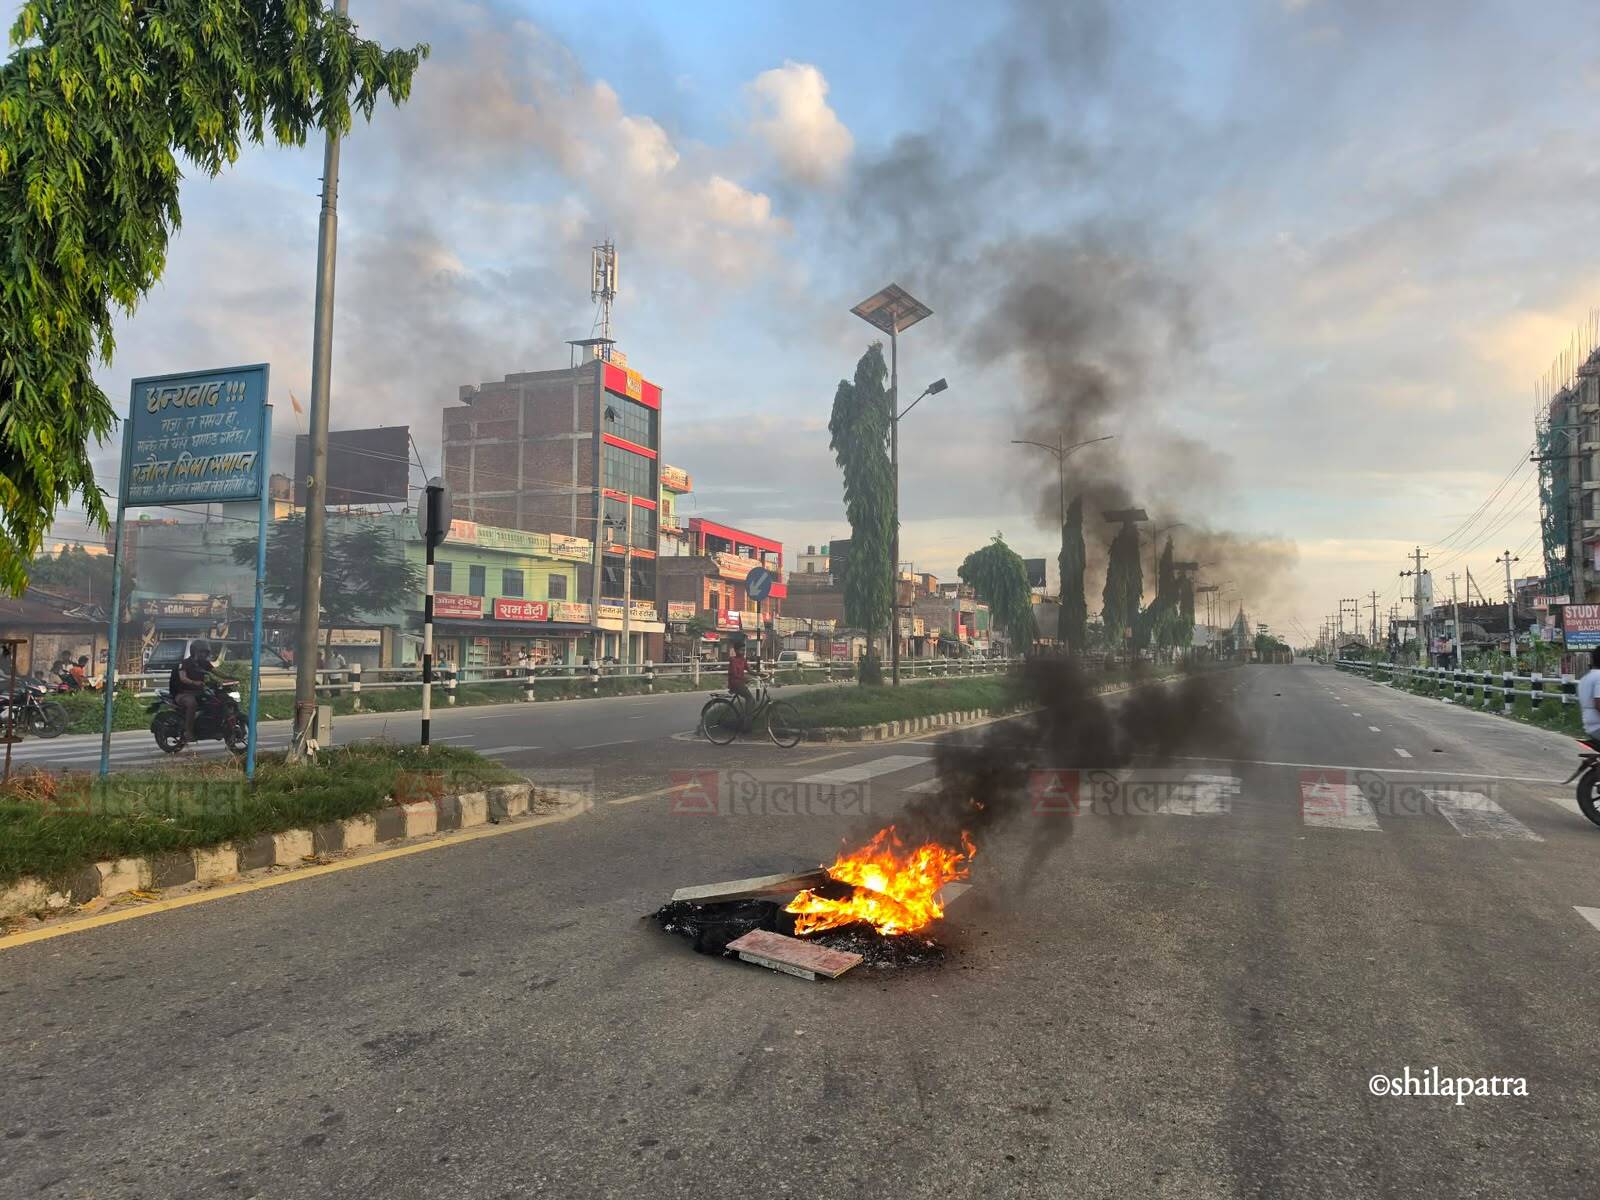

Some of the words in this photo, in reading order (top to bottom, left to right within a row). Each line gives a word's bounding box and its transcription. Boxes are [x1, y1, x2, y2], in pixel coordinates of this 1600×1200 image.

[146, 381, 225, 414] धन्यवाद
[500, 604, 522, 618] राम
[1566, 605, 1599, 619] STUDY
